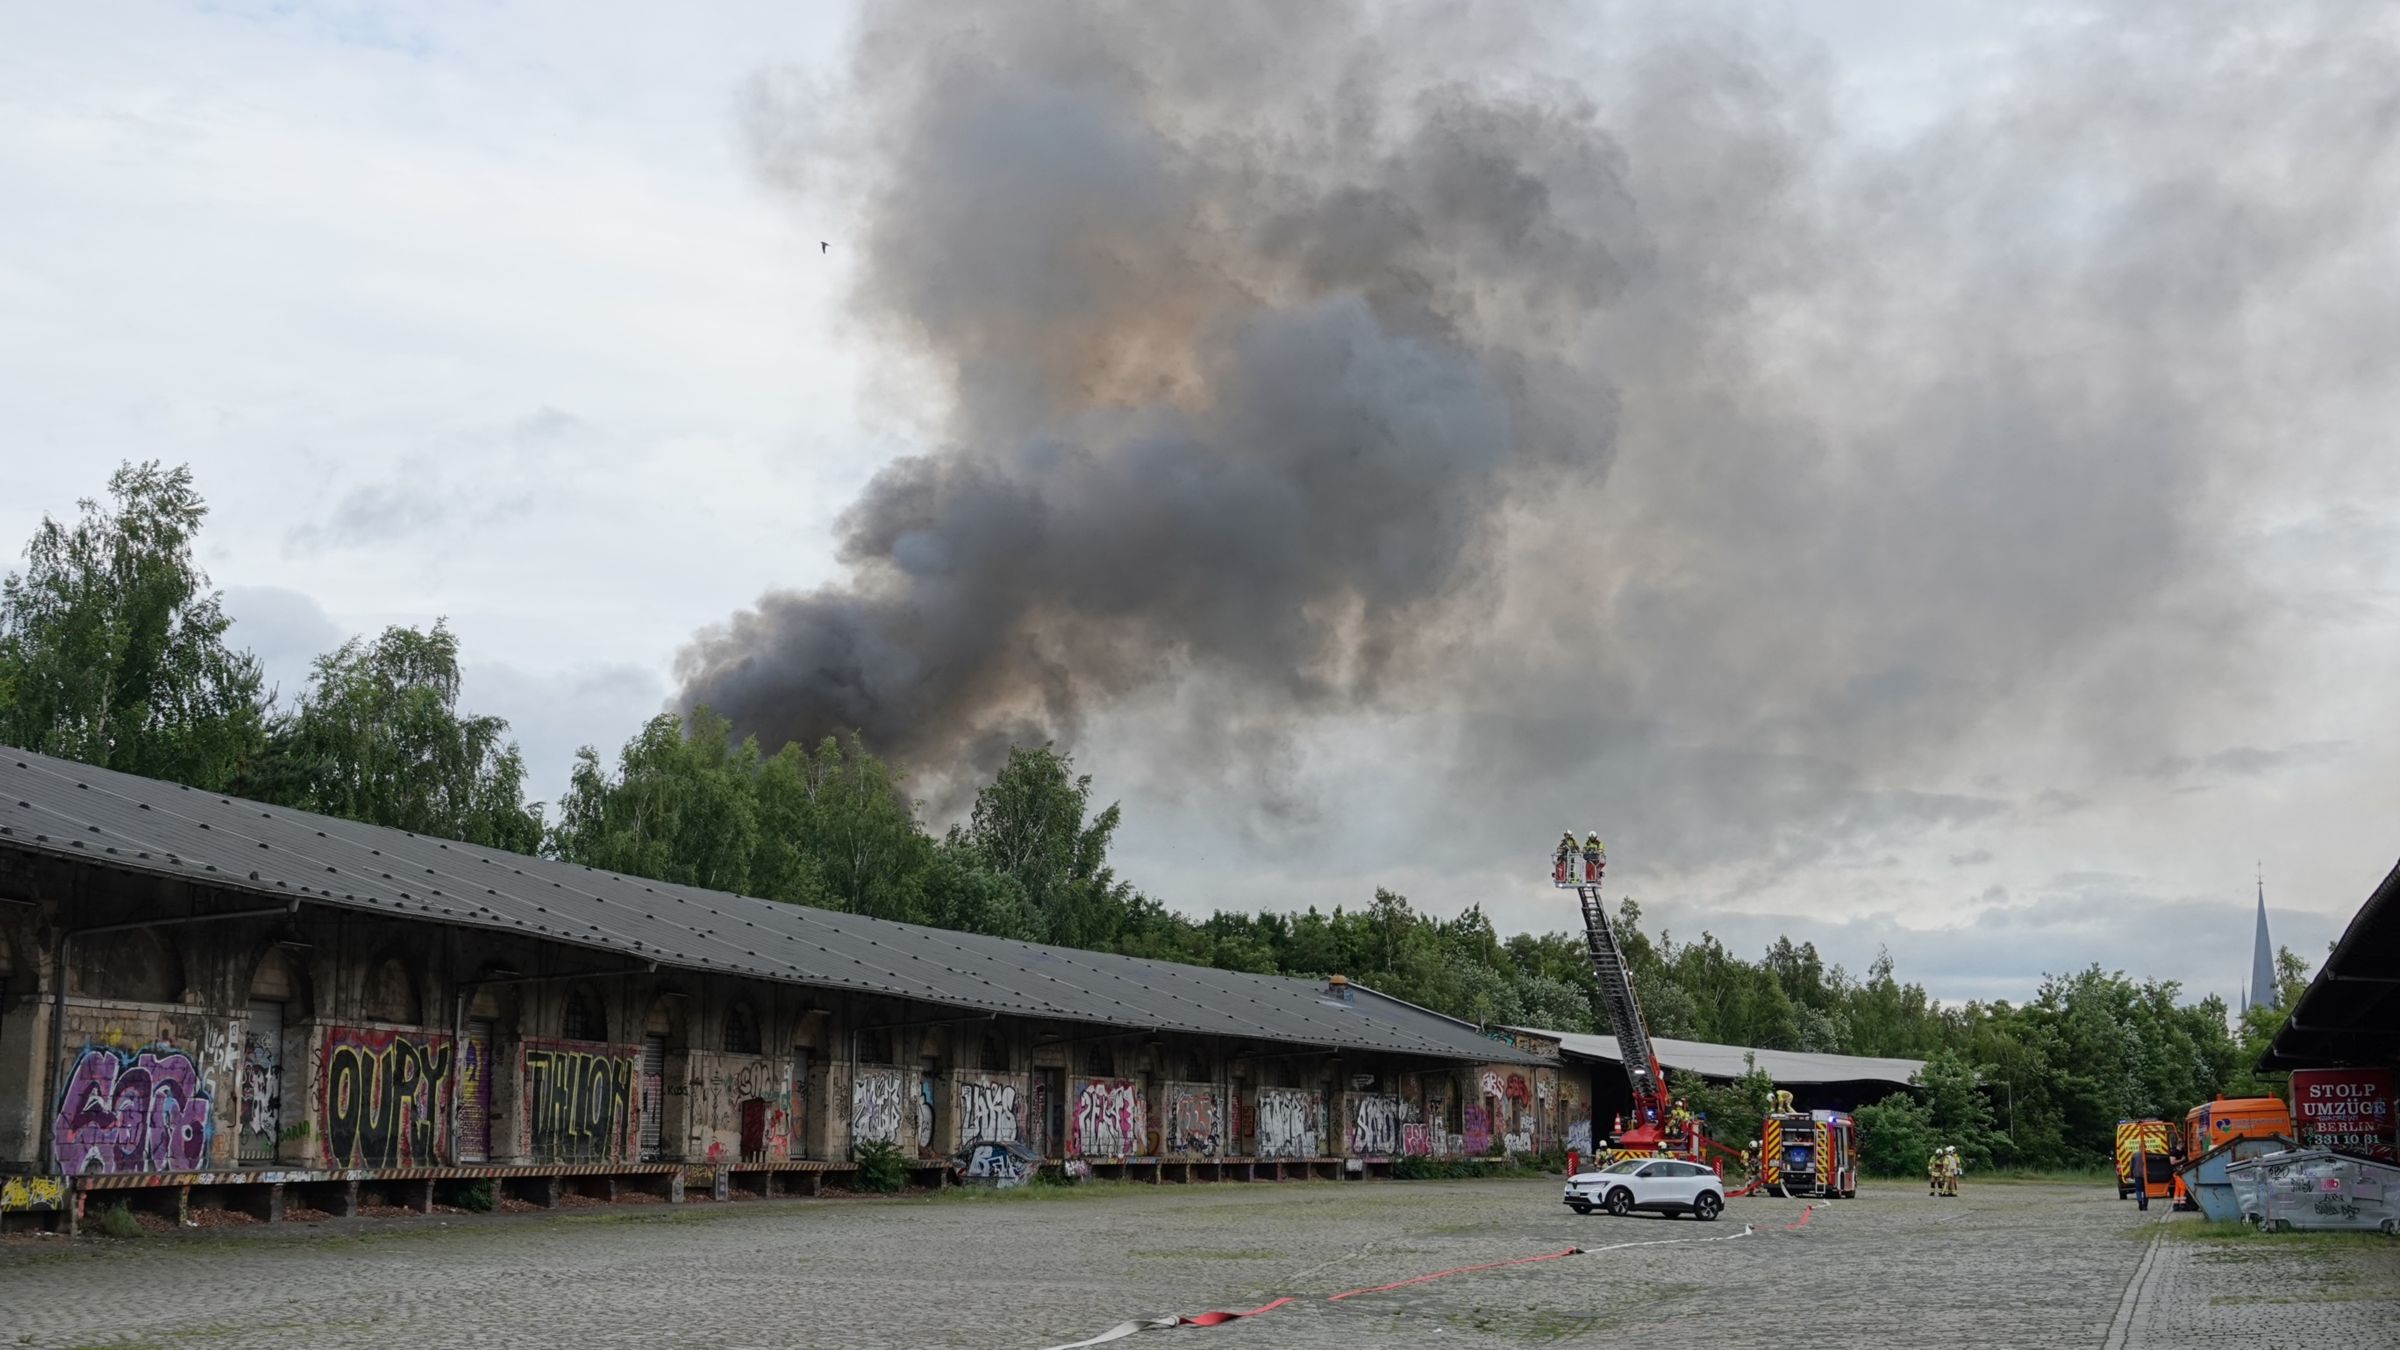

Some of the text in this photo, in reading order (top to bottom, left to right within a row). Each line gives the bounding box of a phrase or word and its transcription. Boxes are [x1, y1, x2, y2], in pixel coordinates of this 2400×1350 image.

[2309, 1083, 2376, 1098] STOLP
[328, 1035, 451, 1168] OURY
[2303, 1098, 2386, 1116] UMZÜGE
[2317, 1122, 2375, 1132] BERLIN
[2314, 1134, 2339, 1145] 331
[2343, 1134, 2360, 1144] 10
